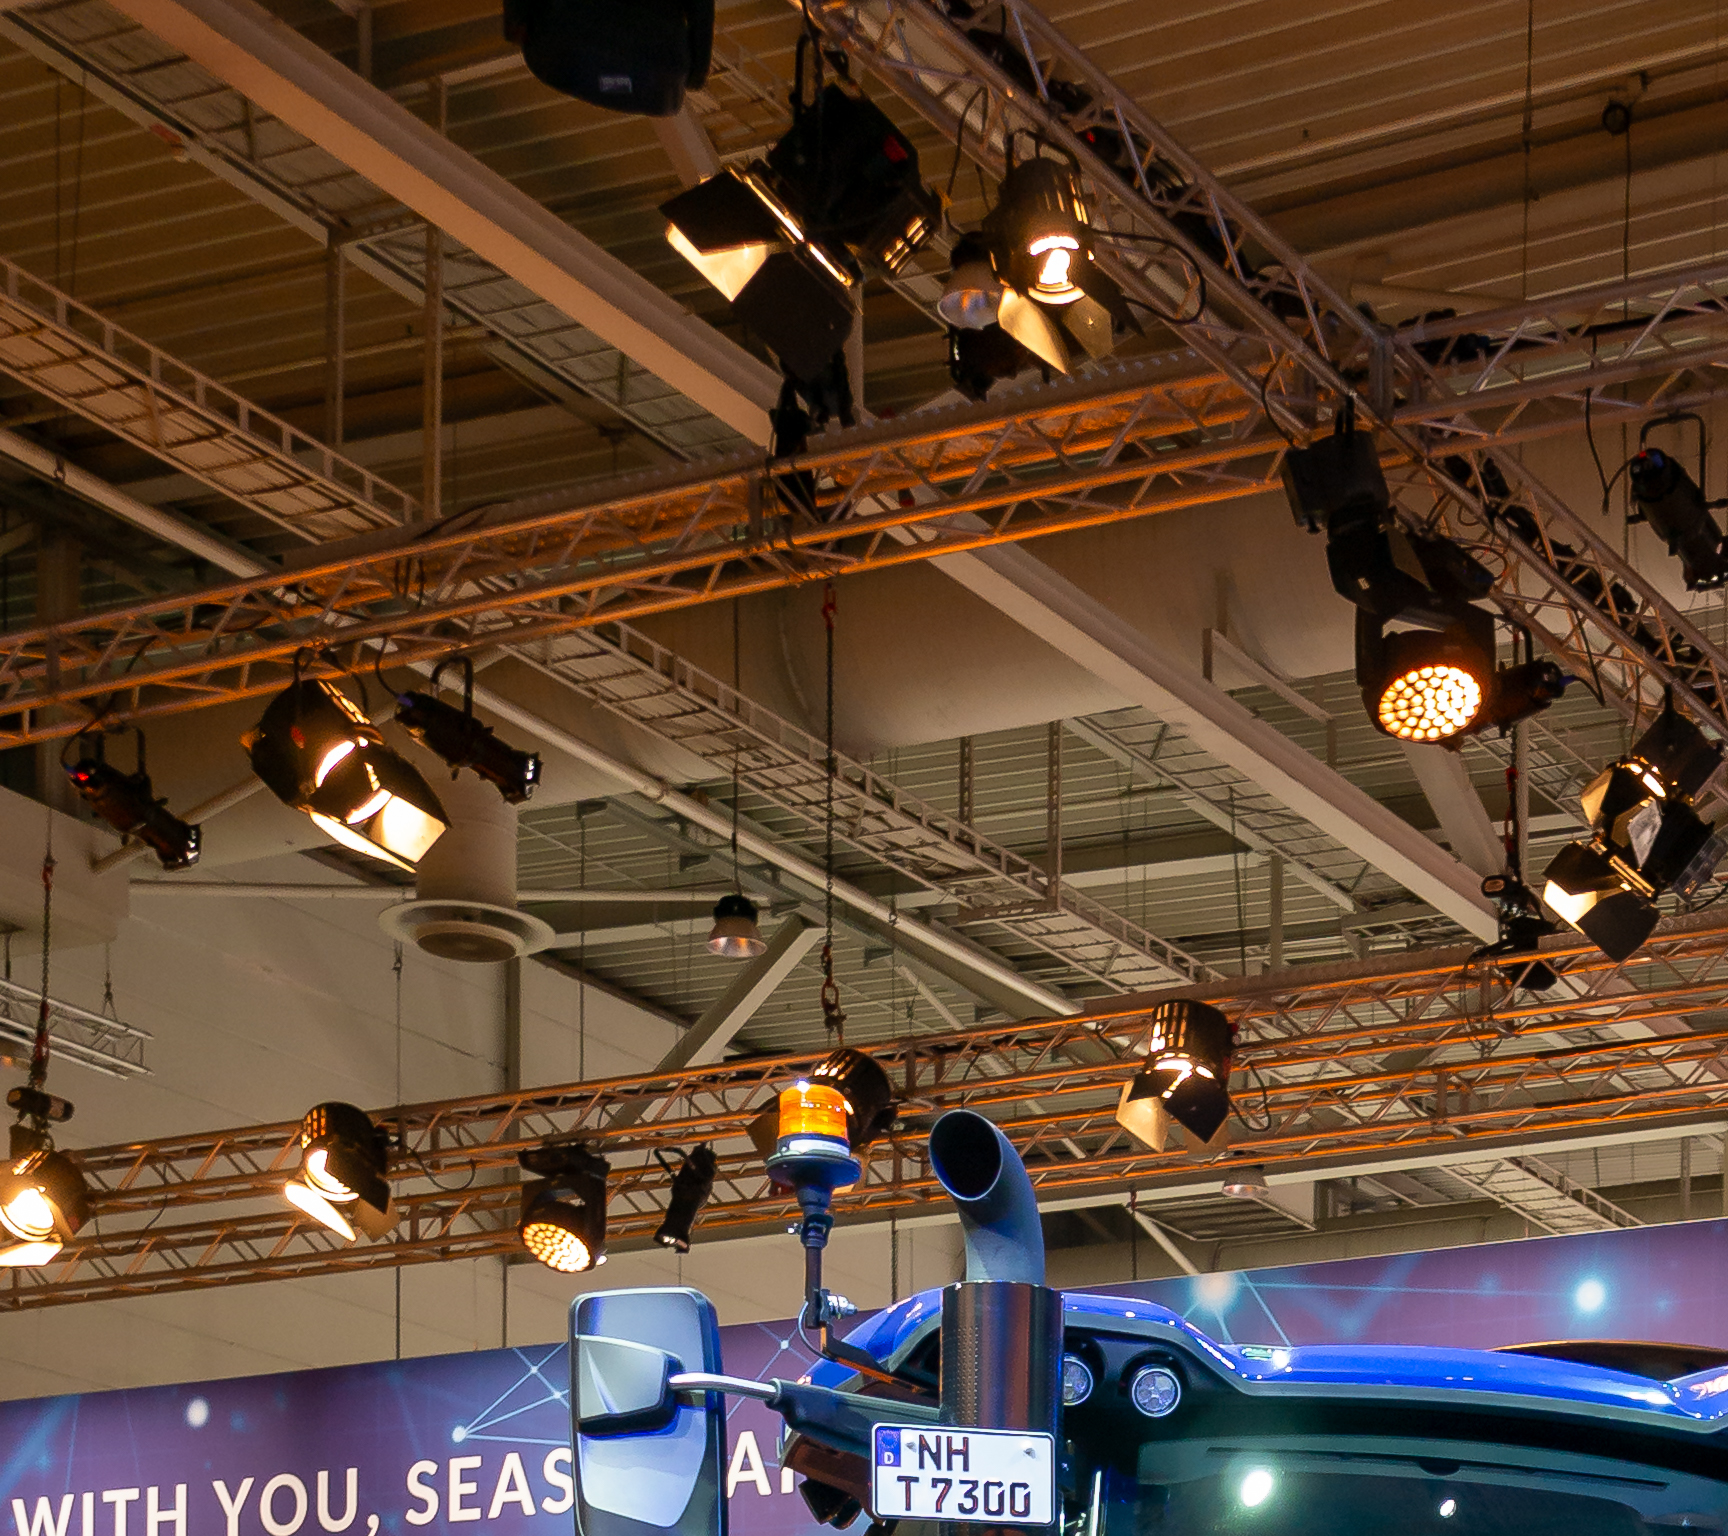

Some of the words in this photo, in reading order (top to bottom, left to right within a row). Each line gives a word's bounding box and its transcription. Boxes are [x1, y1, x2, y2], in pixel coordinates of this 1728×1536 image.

[918, 1434, 970, 1472] NH
[404, 1447, 574, 1526] SEAS
[896, 1475, 920, 1512] T
[931, 1477, 1032, 1518] 7300
